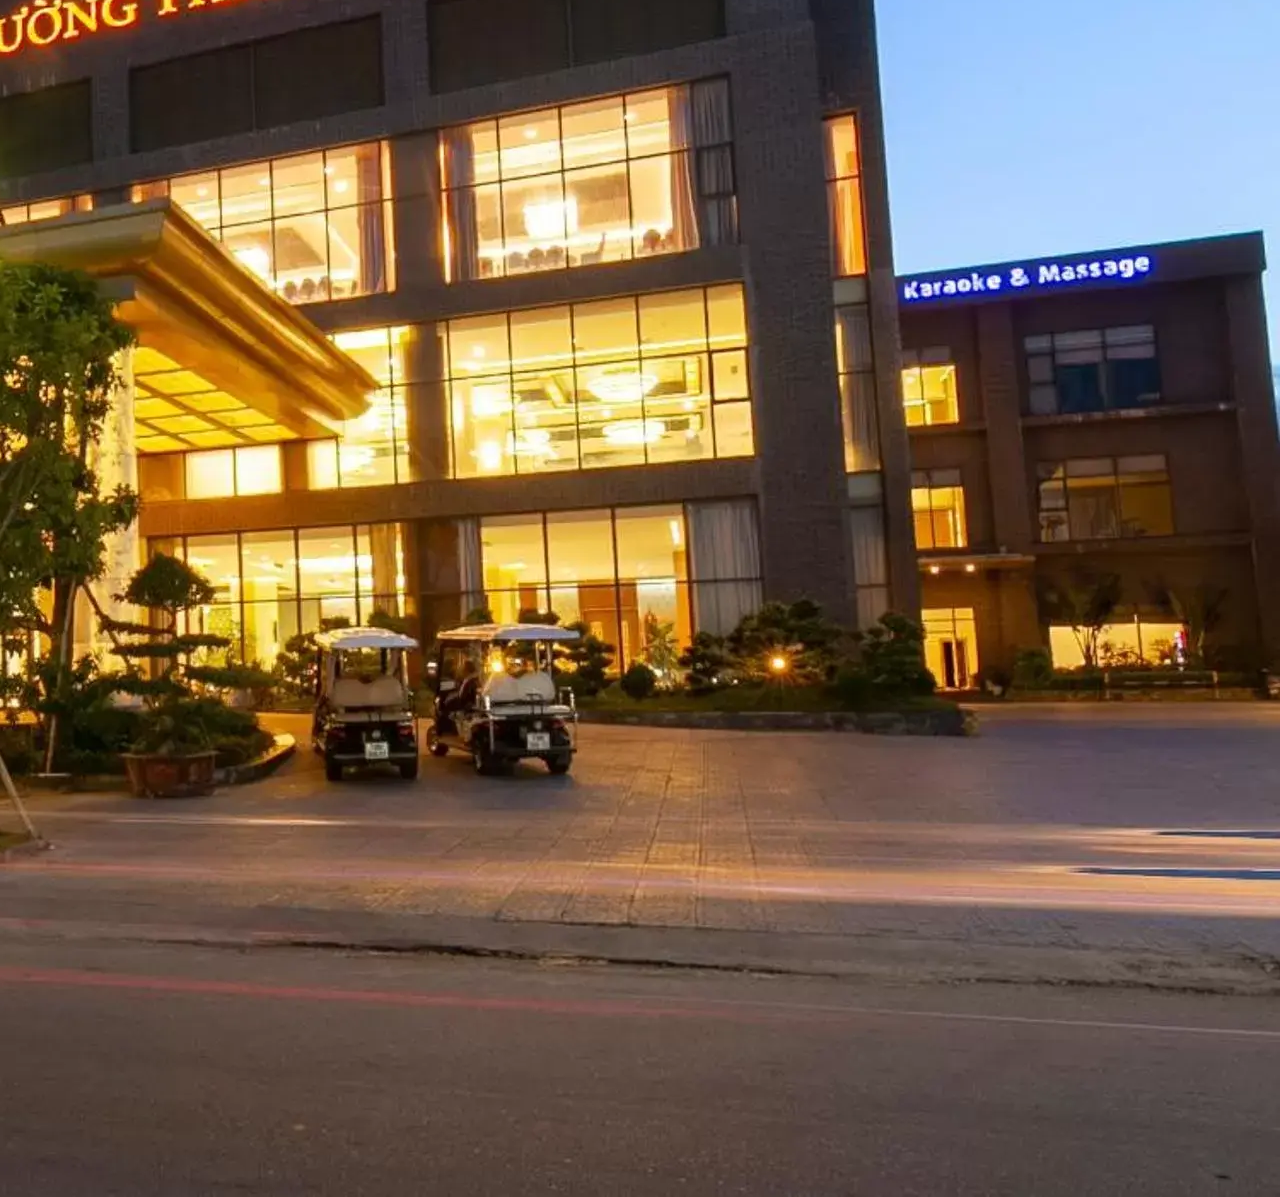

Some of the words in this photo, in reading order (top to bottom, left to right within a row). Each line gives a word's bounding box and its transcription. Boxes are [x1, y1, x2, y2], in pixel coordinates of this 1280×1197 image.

[903, 272, 1002, 301] Karaoke
[1009, 267, 1030, 287] &
[1037, 255, 1151, 284] Massage
